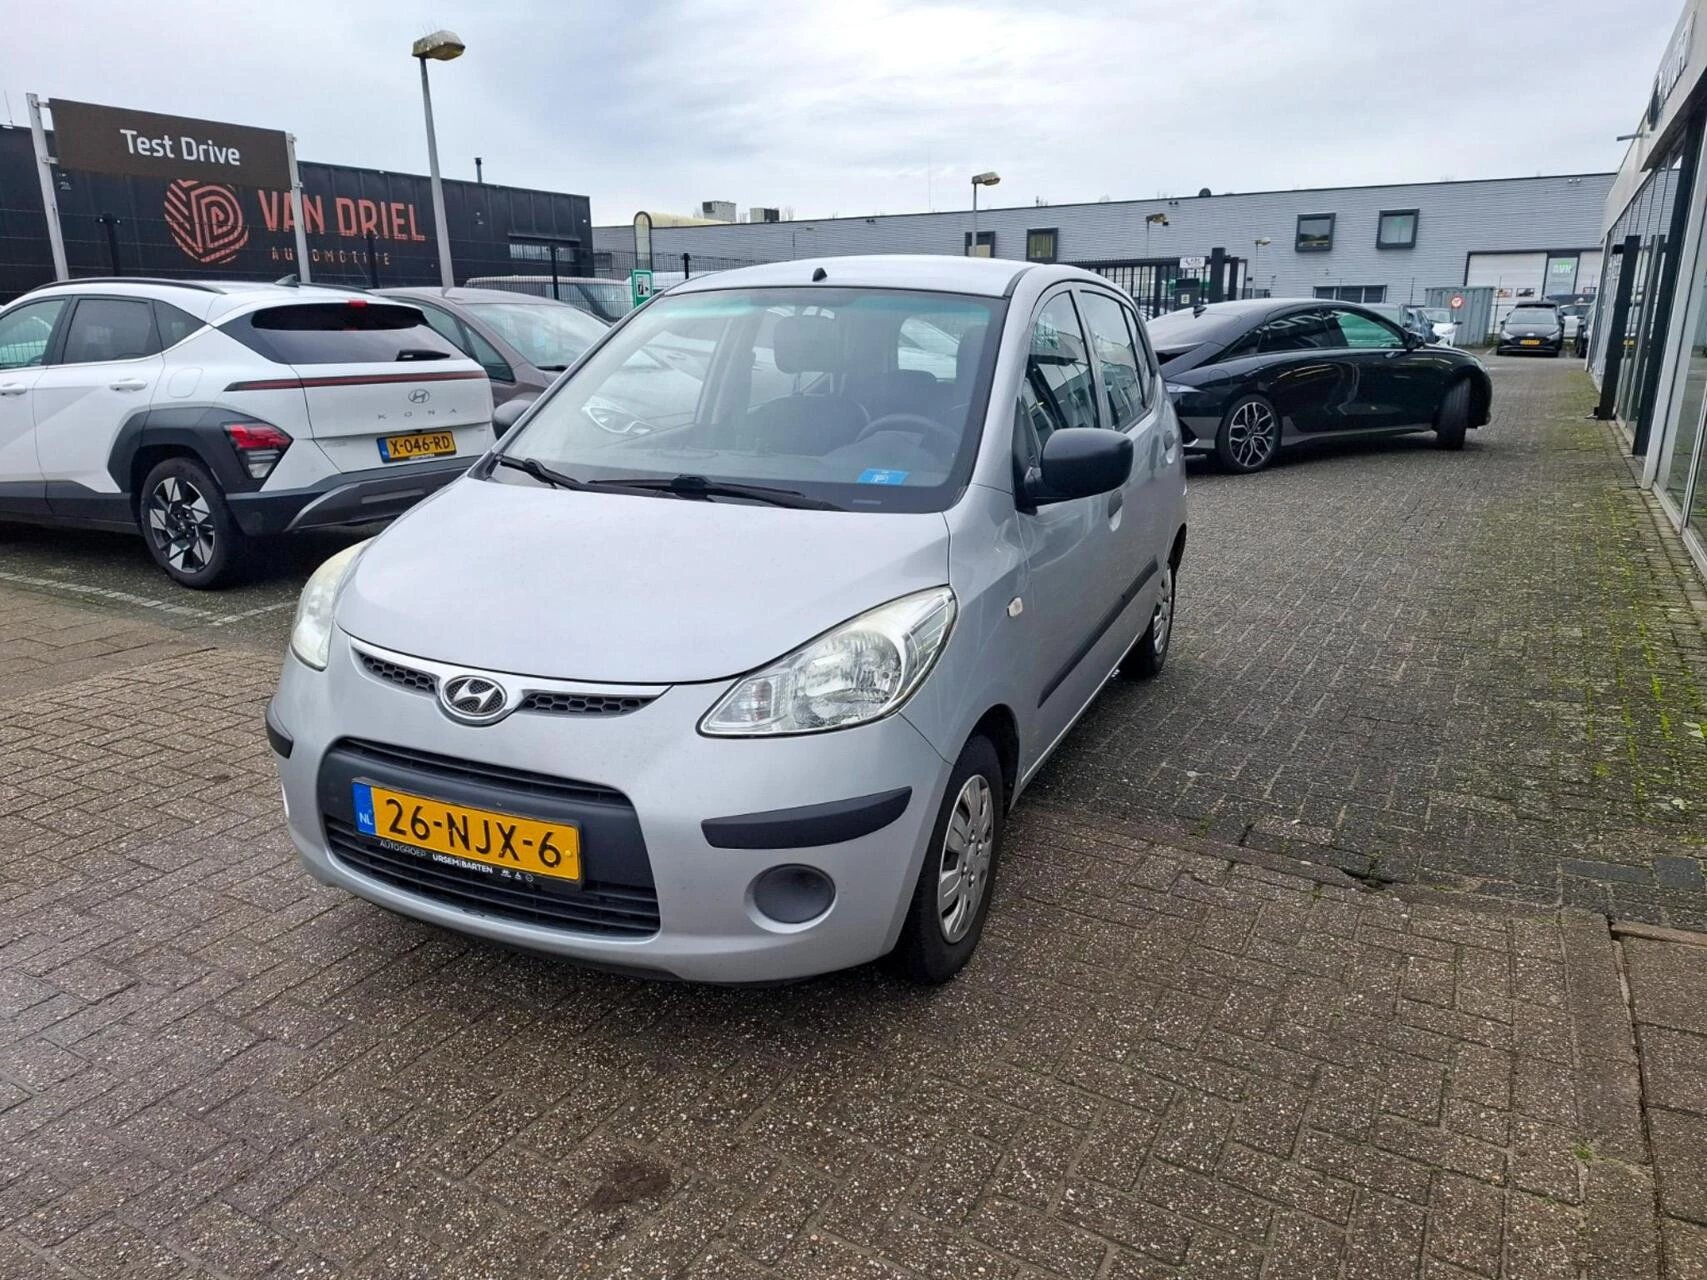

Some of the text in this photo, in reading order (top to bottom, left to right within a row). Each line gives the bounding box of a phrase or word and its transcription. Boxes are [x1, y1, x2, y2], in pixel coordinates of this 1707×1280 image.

[120, 129, 241, 166] Test Drive
[258, 190, 426, 242] VAN DRIEL
[271, 247, 391, 266] AUOMOTIE
[377, 408, 457, 420] KONA
[389, 435, 451, 456] X-046-RD
[359, 812, 374, 827] NL
[386, 798, 562, 869] 26-NJX-6
[379, 839, 427, 858] AUTOGROEP
